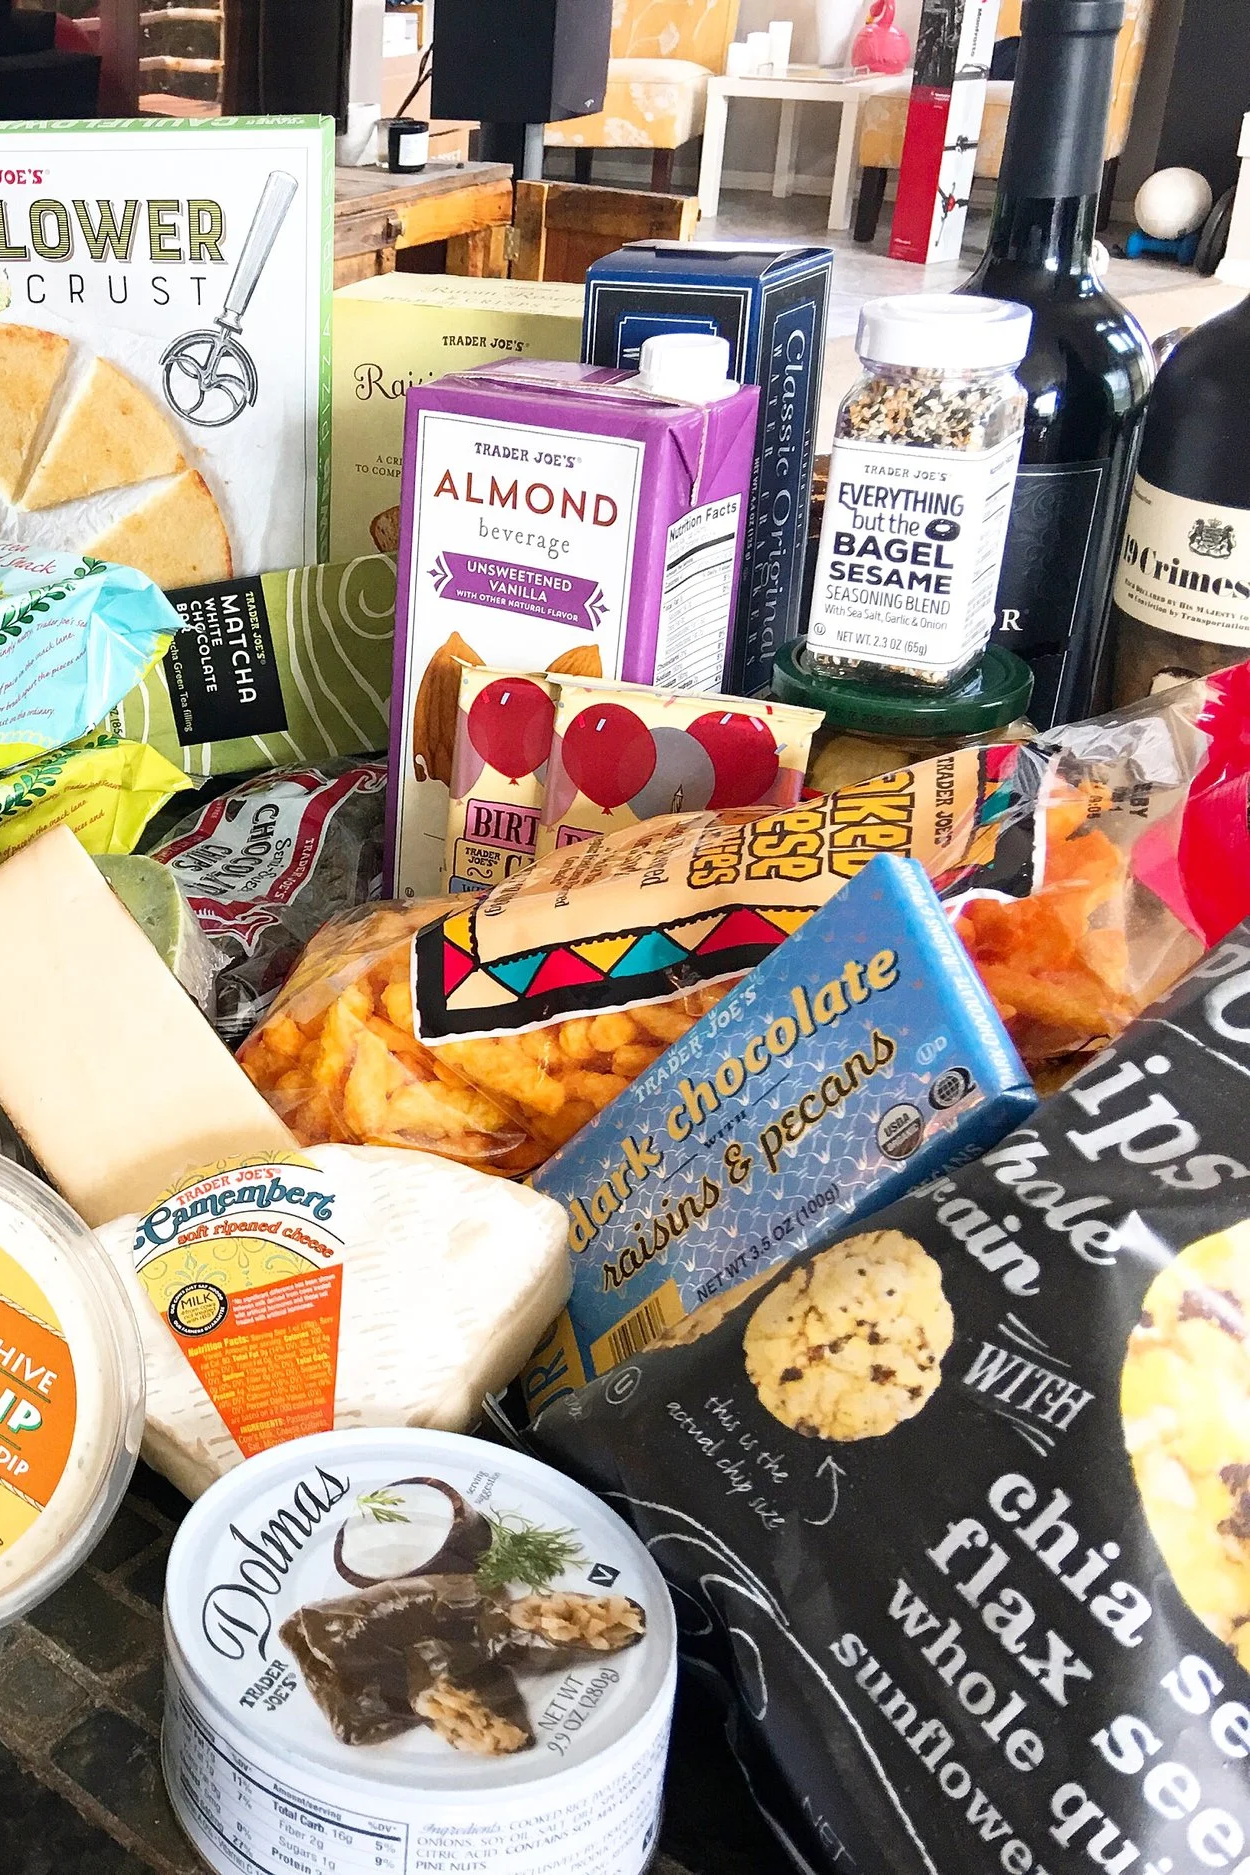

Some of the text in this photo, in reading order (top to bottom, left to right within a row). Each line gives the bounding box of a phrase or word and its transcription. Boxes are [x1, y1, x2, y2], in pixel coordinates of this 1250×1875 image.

[26, 274, 207, 306] CRUST
[442, 335, 525, 352] TRADER JOE'S
[475, 442, 576, 468] TRADER JOE'S
[864, 465, 948, 482] TRADER JOE'S
[434, 469, 618, 527] ALMOND
[758, 328, 807, 664] Classic Original
[838, 481, 965, 517] EVERYTHING
[479, 518, 570, 560] beverage
[669, 501, 737, 543] Nutrition Facts
[851, 511, 921, 536] but the
[833, 531, 954, 569] BAGEL
[1123, 534, 1250, 601] 19 Crimes
[467, 560, 573, 592] UNSWEETENED
[489, 580, 548, 603] VANILLA
[829, 561, 952, 595] SESAME
[456, 589, 579, 622] WITH OTHER NATURAL FLAVOR
[825, 604, 911, 626] With Sea Garlic
[826, 584, 951, 616] SEASONING BLEND
[204, 598, 223, 647] WHITE
[245, 591, 266, 661] TRADER JOE'S
[837, 630, 928, 656] NET (65g)
[190, 600, 218, 693] CHOCOLATE
[220, 594, 257, 704] MATCHA
[174, 662, 184, 691] Green
[935, 756, 955, 808] TRADER
[470, 806, 541, 846] BIRT
[465, 847, 501, 859] TRADER
[567, 1132, 664, 1255] dark
[665, 948, 900, 1142] chocolate
[703, 1109, 749, 1151] WITH
[601, 1030, 897, 1292] raisins & pecans
[176, 1166, 276, 1206] TRADER JOE'S
[134, 1177, 336, 1250] Camembert
[177, 1219, 335, 1259] soft ripened cheese
[696, 1182, 841, 1303] NET (100g)
[181, 1293, 214, 1310] MILK
[962, 1341, 1097, 1432] WITH
[666, 1402, 753, 1495] actual chip
[704, 1396, 789, 1484] this the
[201, 1463, 351, 1663] Dolmas
[988, 1473, 1153, 1649] chia
[925, 1516, 1095, 1708] flax
[239, 1658, 290, 1711] TRADER
[266, 1672, 298, 1713] JOE'S
[887, 1578, 1045, 1772] whole
[537, 1673, 586, 1734] NET WT
[566, 1667, 621, 1734] OZ (280g)
[272, 1801, 397, 1854] Total Carb. 16g 5%
[279, 1819, 324, 1850] Fiber 2g
[271, 1847, 313, 1875] Protein
[278, 1836, 318, 1863] Sugars
[416, 1859, 488, 1871] PINE NUTS
